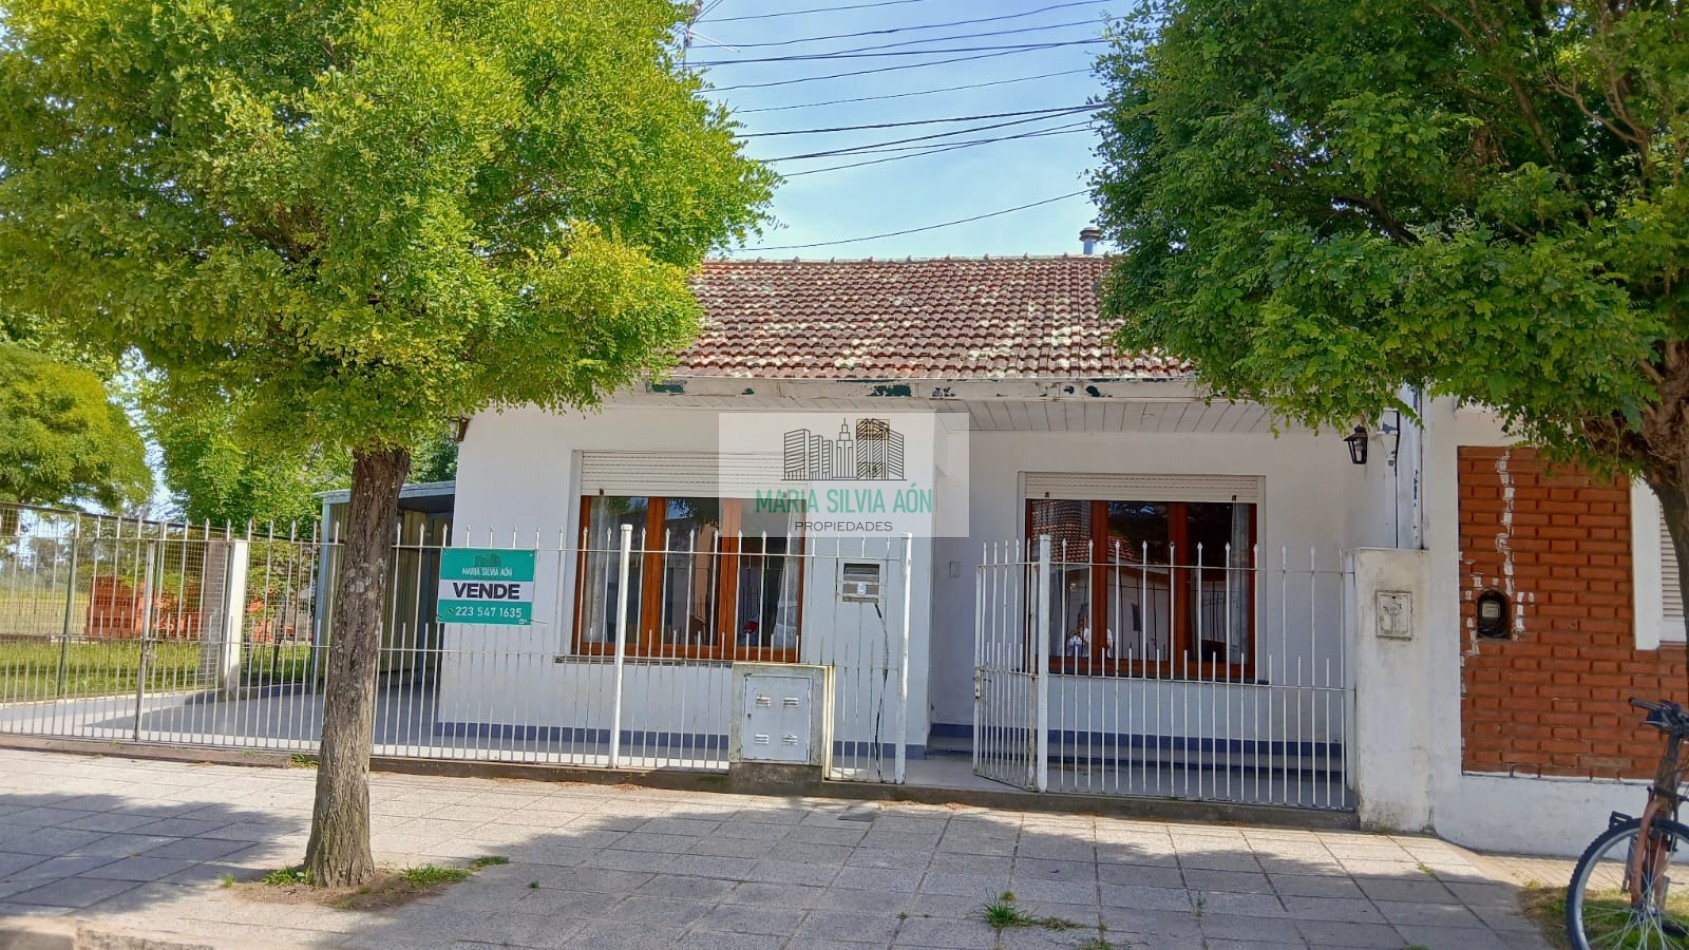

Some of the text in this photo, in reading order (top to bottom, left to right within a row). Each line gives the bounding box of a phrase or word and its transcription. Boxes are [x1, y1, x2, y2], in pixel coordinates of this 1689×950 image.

[482, 567, 498, 576] SILVIA
[452, 582, 521, 600] VENDE
[455, 606, 523, 618] 223 547 1635
